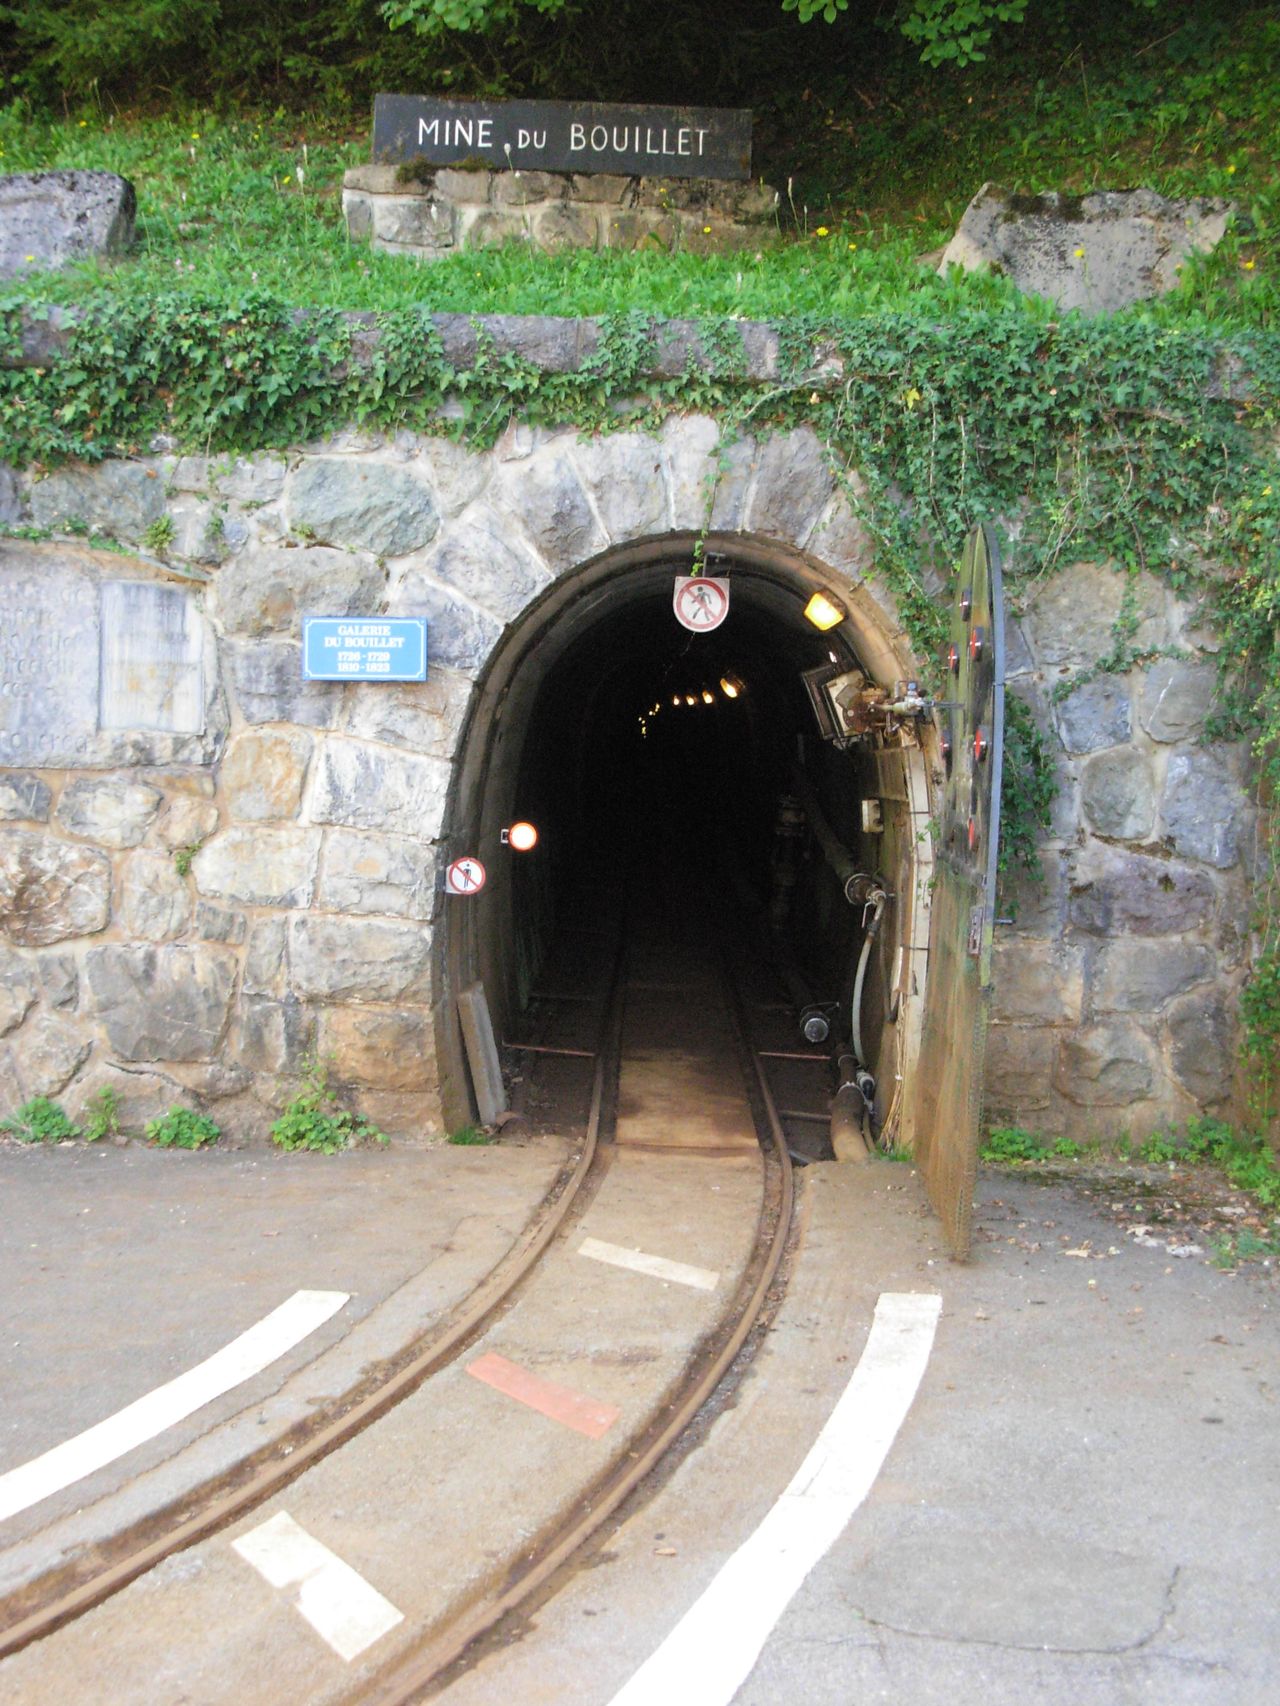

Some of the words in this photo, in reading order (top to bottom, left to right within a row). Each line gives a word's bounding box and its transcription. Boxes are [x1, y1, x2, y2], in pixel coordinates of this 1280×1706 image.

[418, 117, 494, 148] MINE
[518, 129, 547, 150] DU
[570, 123, 709, 156] BOUILLET
[338, 625, 391, 636] GALERIE
[324, 637, 340, 648] DU
[345, 637, 405, 648] BOUILLET
